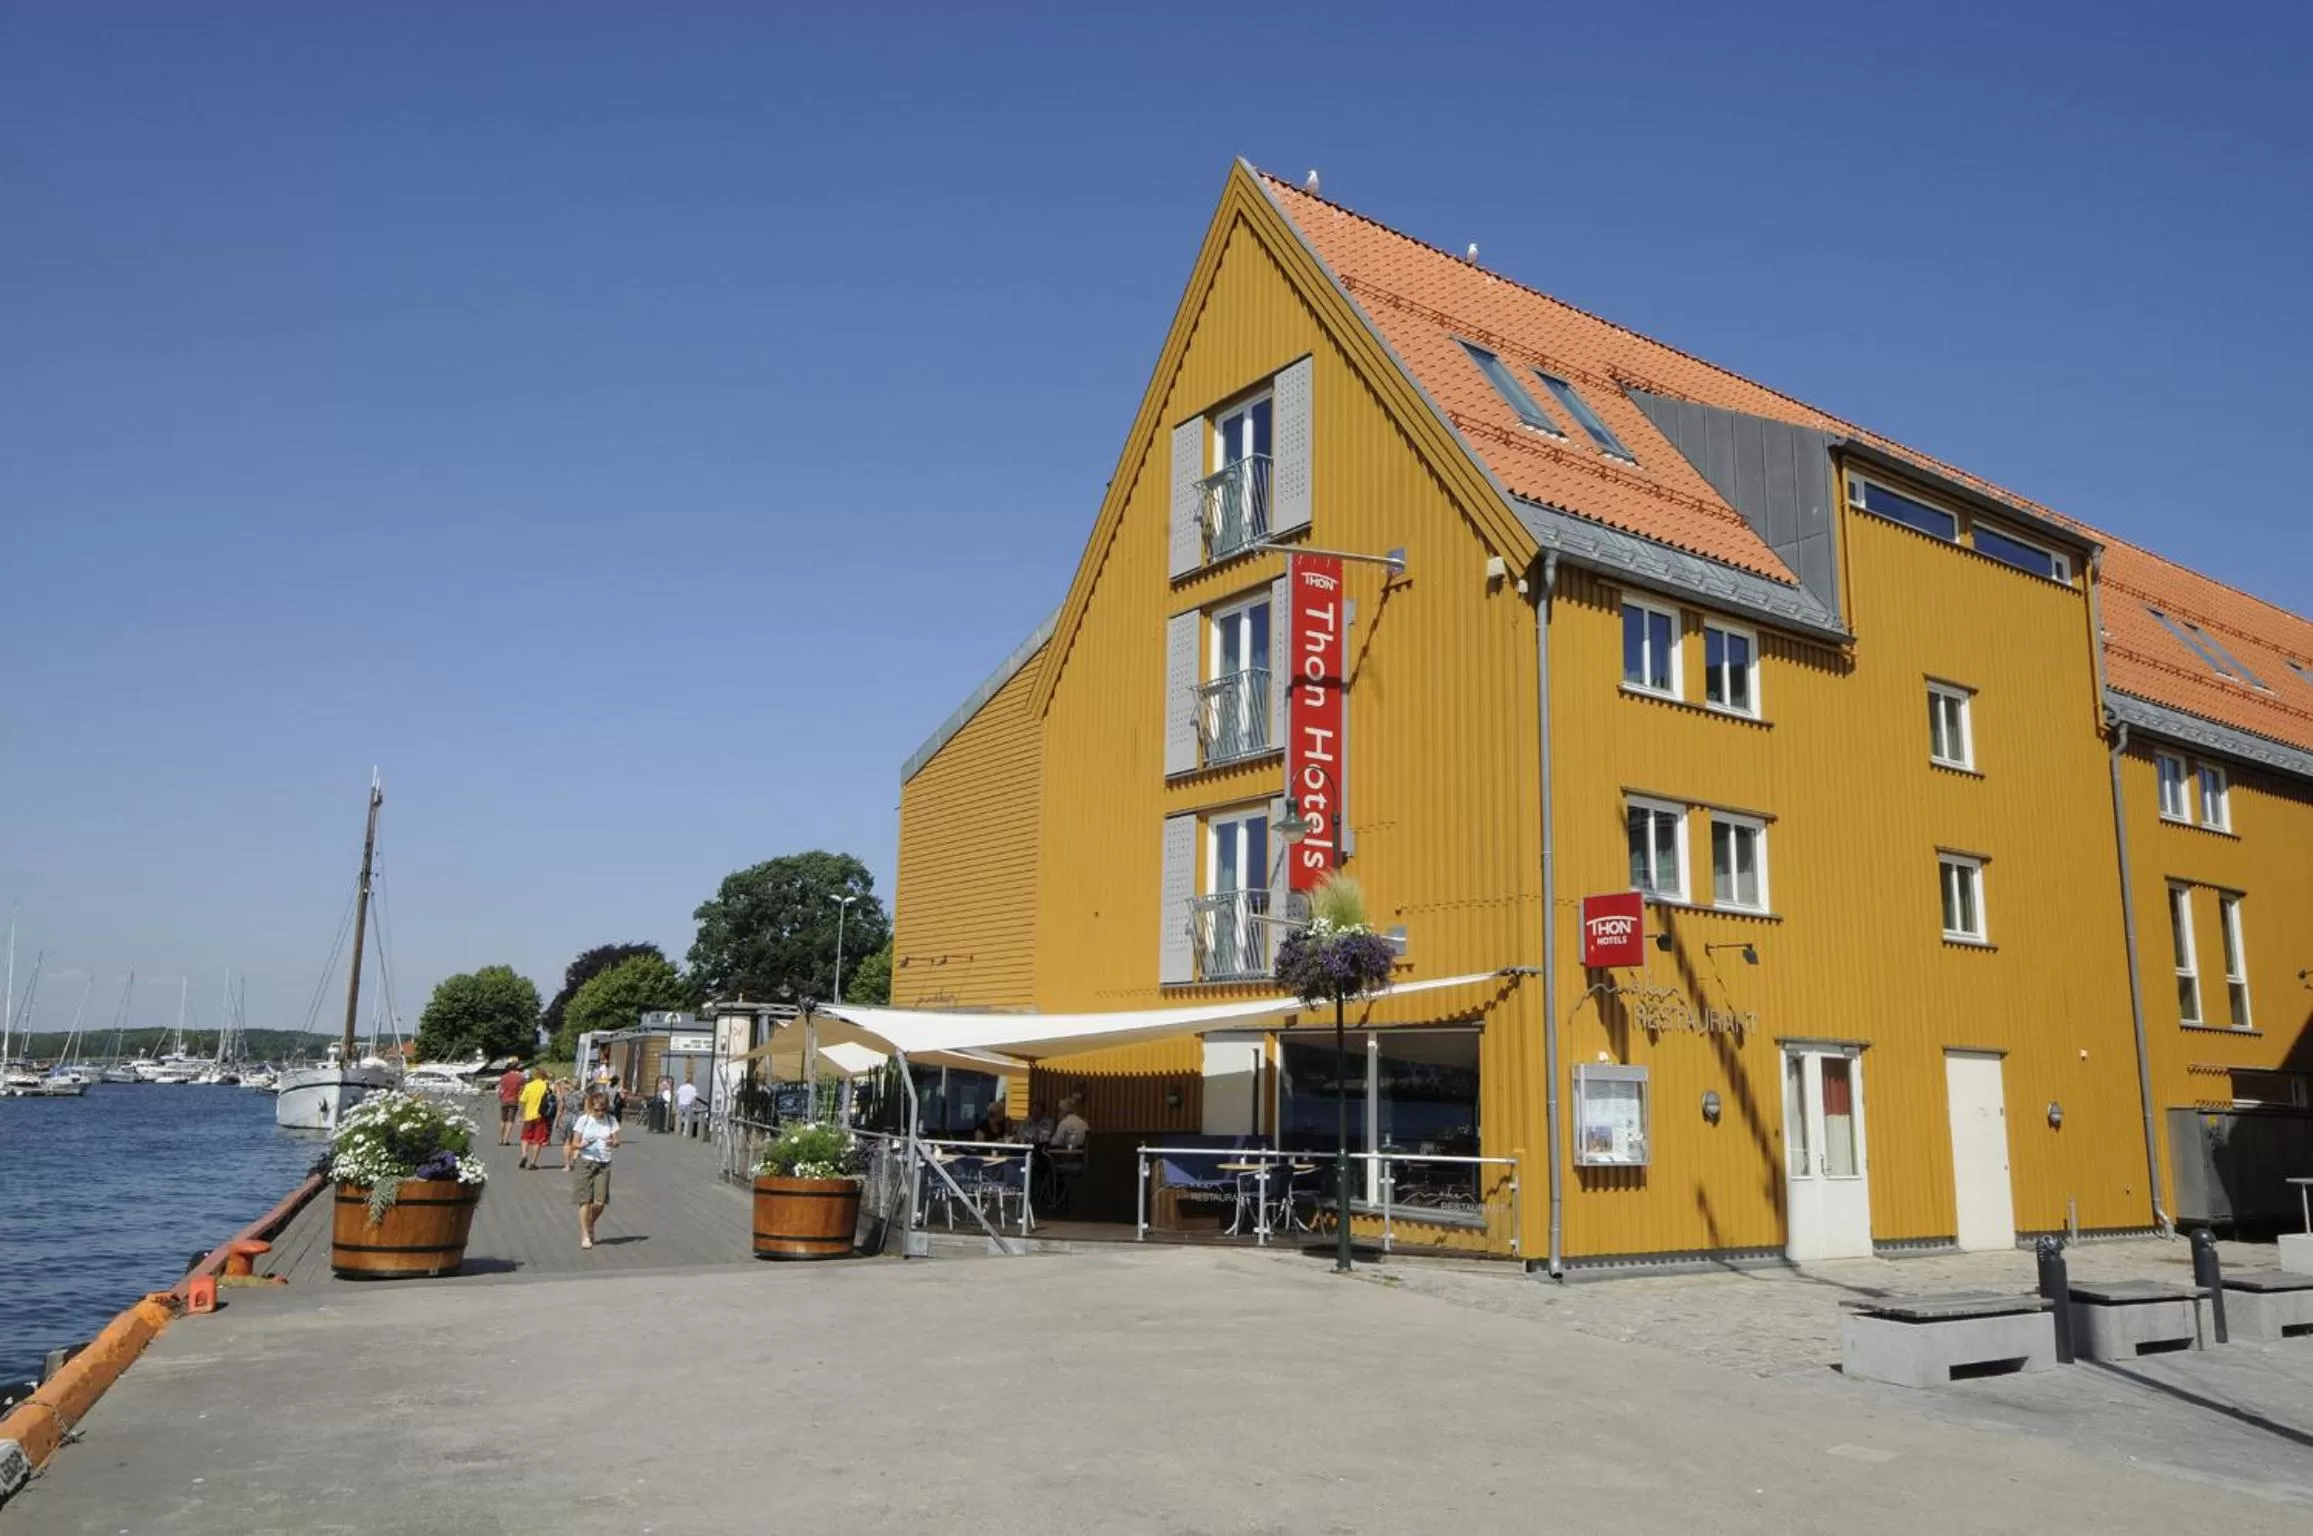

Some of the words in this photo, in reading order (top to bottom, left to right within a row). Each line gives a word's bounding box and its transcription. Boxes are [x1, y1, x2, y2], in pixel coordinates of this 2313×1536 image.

[1301, 572, 1339, 591] THON
[1304, 602, 1334, 707] Thon
[1303, 726, 1333, 869] Hotels
[1586, 915, 1637, 936] THON
[1597, 935, 1628, 946] HOTELS
[1634, 1003, 1760, 1036] RESTAURANT
